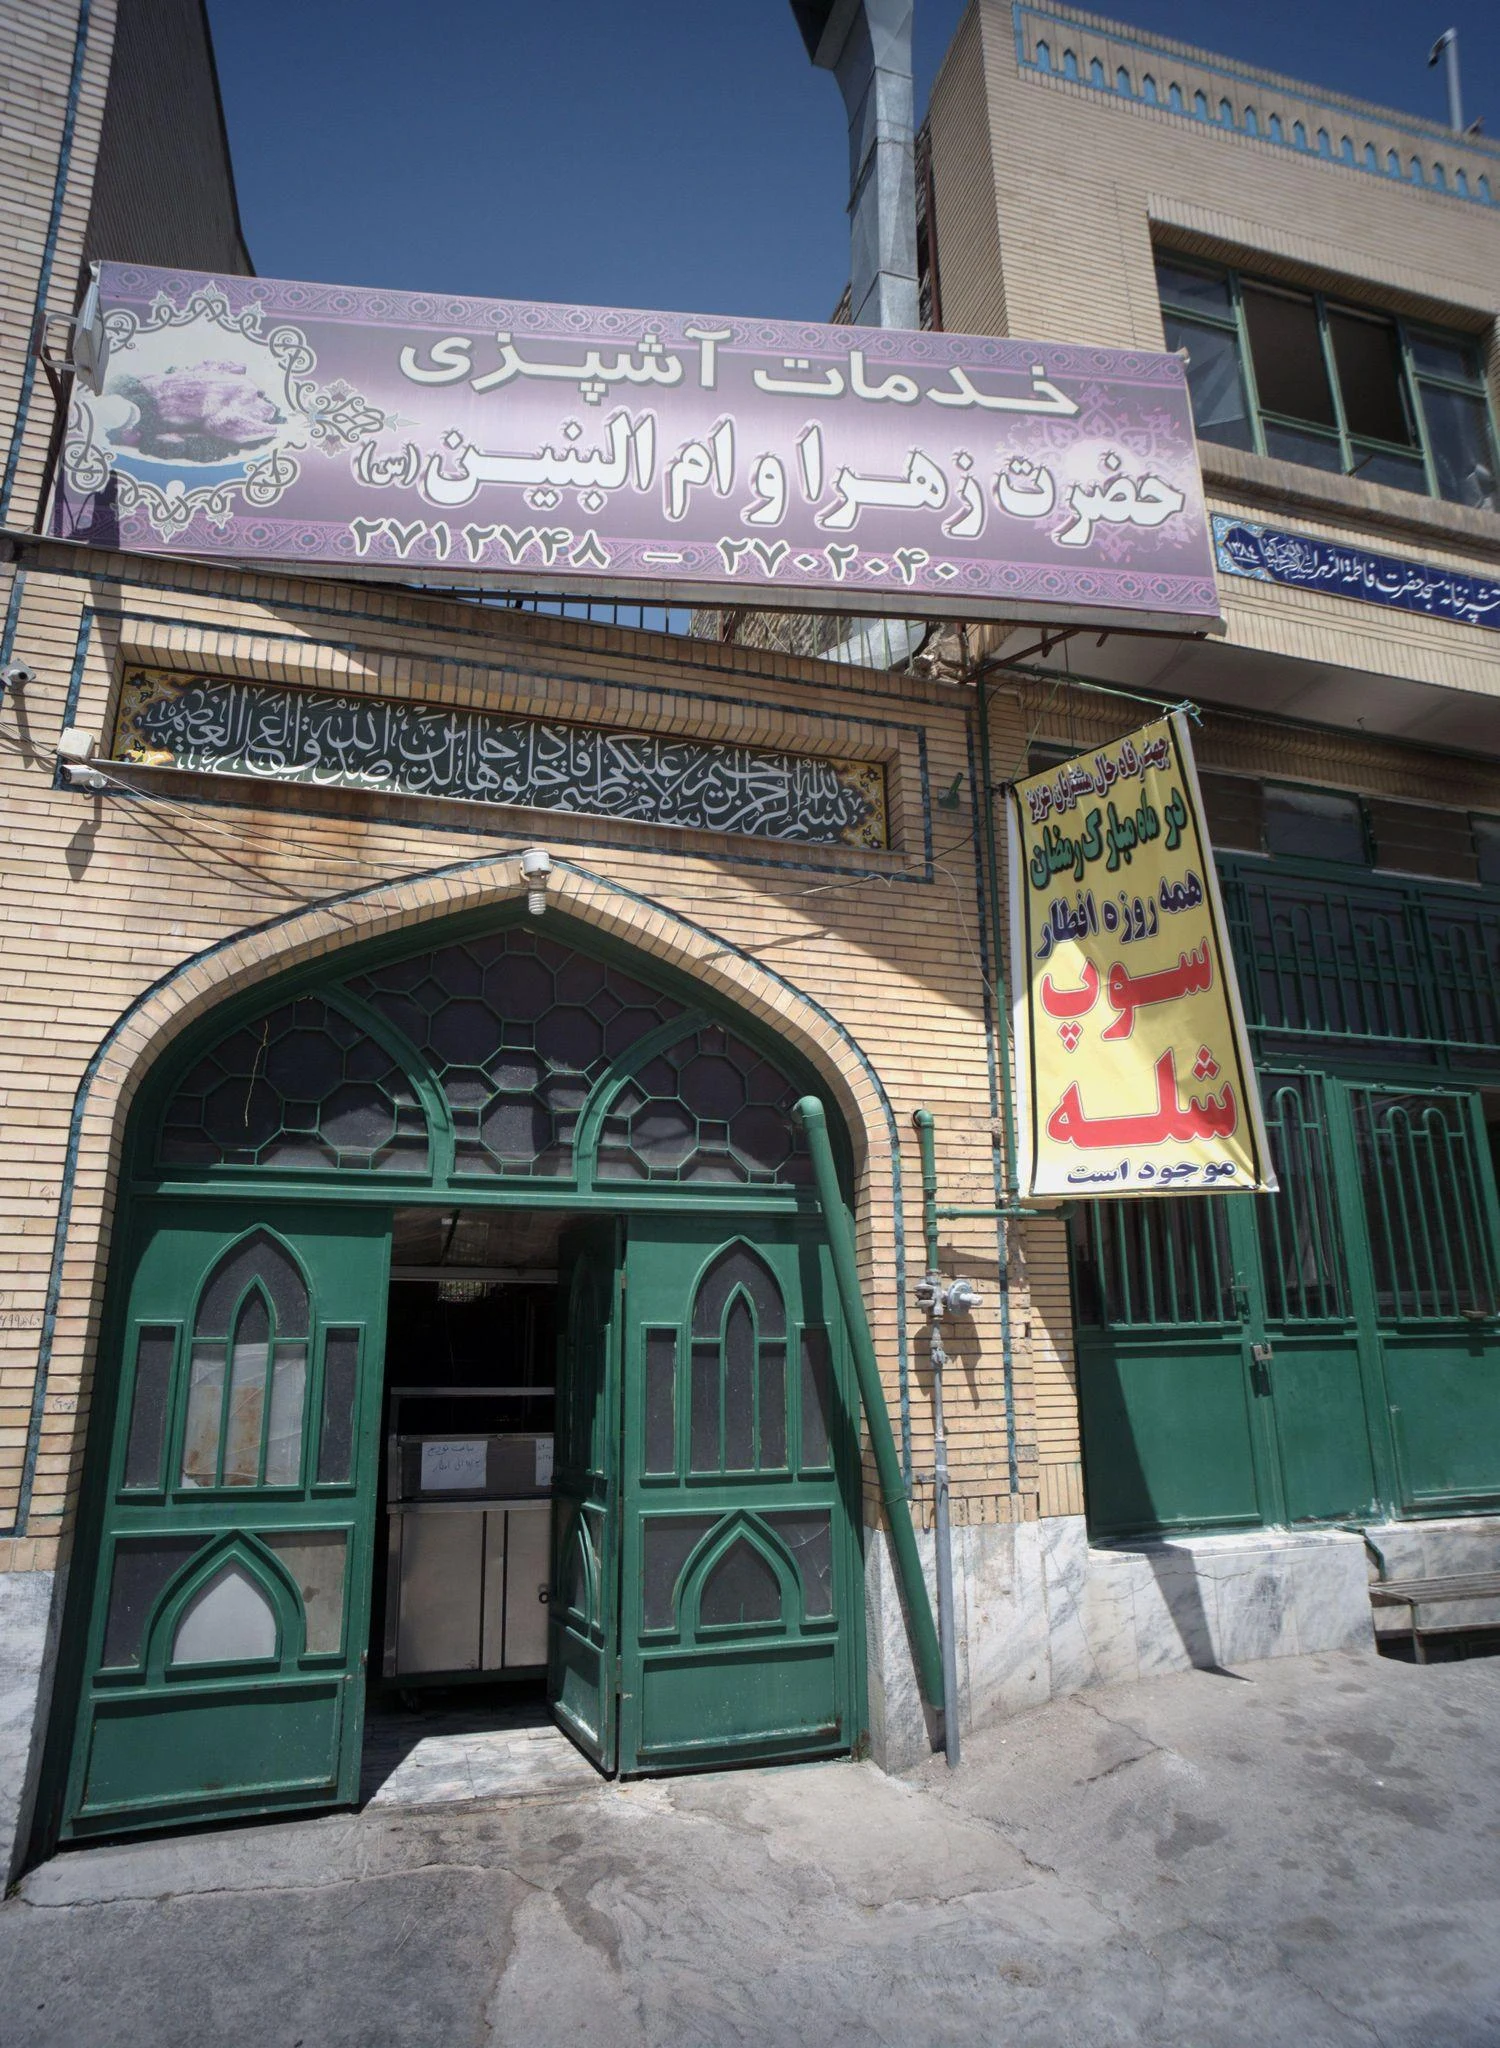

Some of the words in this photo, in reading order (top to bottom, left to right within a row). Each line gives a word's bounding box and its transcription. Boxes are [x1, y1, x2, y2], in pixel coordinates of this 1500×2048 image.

[399, 327, 733, 405] آشپزی
[753, 350, 1080, 418] خدمات
[425, 411, 656, 512] البنین
[666, 418, 736, 520] ام
[744, 453, 787, 526] و
[799, 424, 984, 540] زهرا
[996, 450, 1186, 546] حضرت
[717, 536, 959, 585] ۲۷۰۲۰۴۰
[1376, 570, 1424, 599] حضرت
[1414, 580, 1445, 610] مسجد
[1052, 765, 1094, 813] مشتریان
[1093, 750, 1118, 797] حال
[1117, 739, 1145, 783] رفاه
[1025, 784, 1053, 823] عزیز
[1135, 786, 1161, 844] ماه
[1165, 791, 1187, 850] در
[1030, 824, 1084, 890] رمضان
[1081, 801, 1138, 872] مبارک
[1102, 890, 1160, 944] روزه
[1158, 869, 1203, 914] همه
[1034, 888, 1099, 959] افطار
[1041, 937, 1213, 1053] سوپ
[1047, 1044, 1237, 1149] شله
[1066, 1157, 1130, 1184] است
[1137, 1159, 1237, 1185] موجود
